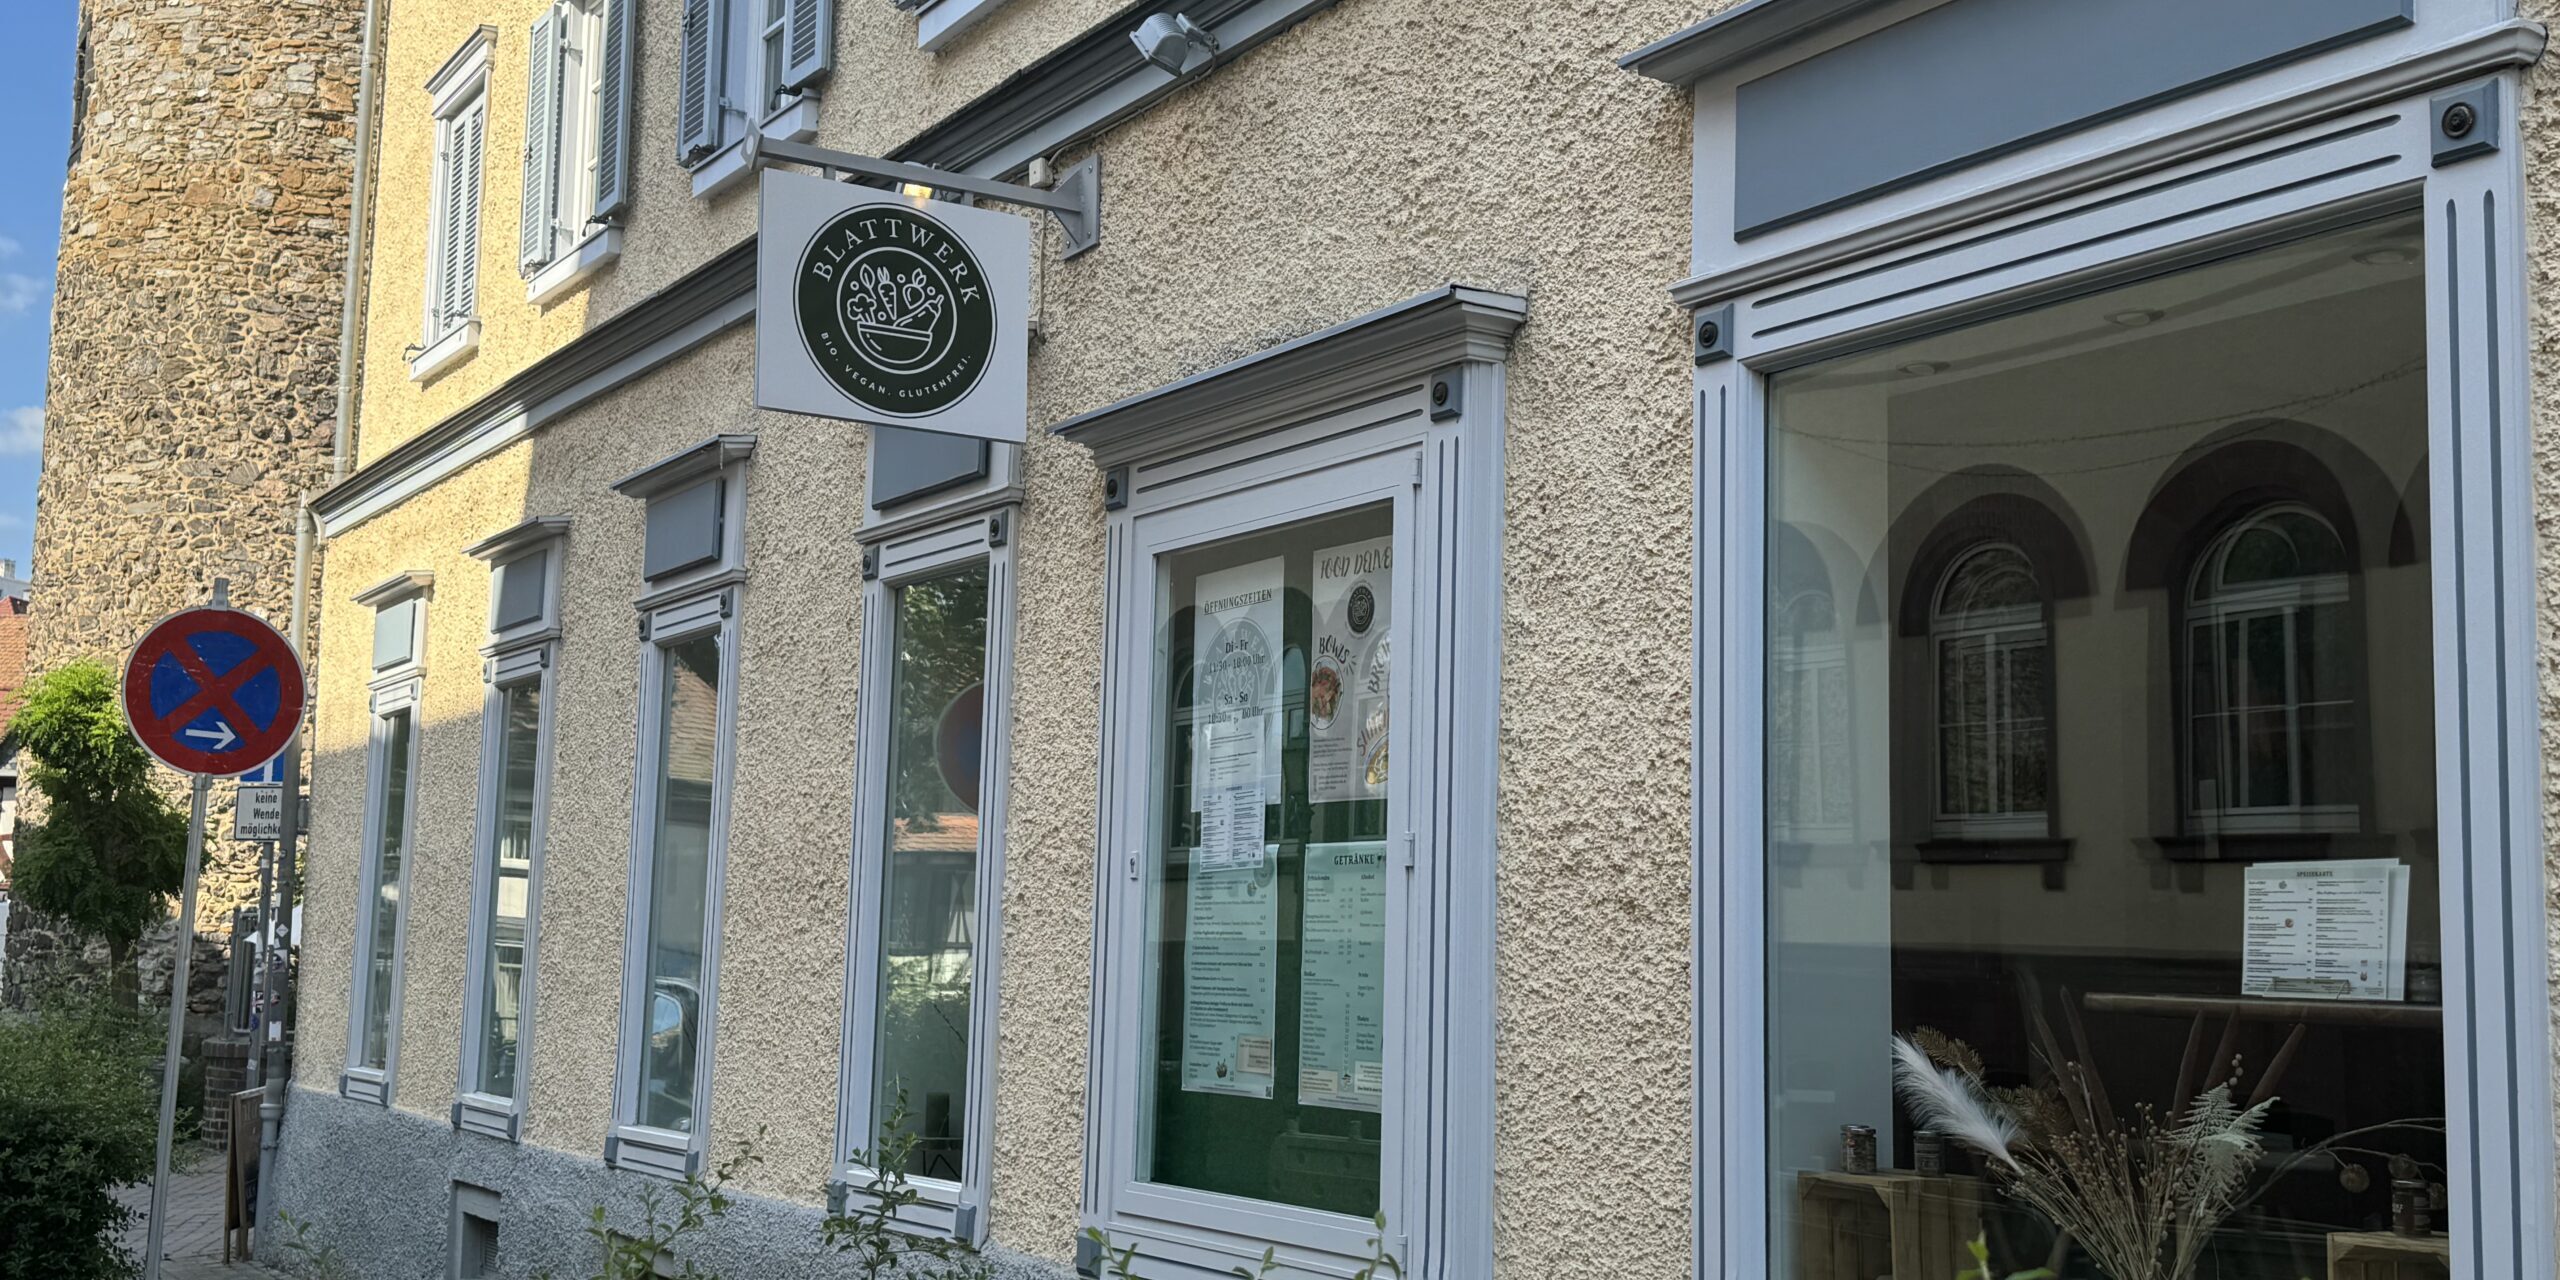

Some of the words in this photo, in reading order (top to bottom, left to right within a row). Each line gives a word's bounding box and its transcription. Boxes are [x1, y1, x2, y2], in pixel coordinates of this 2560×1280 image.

[812, 217, 981, 306] BLATTWERK
[819, 331, 841, 363] BIO.
[843, 363, 893, 397] VEGAN.
[898, 354, 974, 399] GLUTENFREI.
[1203, 588, 1273, 614] ÖFFNUNGSZEITEN
[1225, 641, 1234, 654] Di
[1240, 639, 1249, 651] Fr
[1318, 635, 1350, 665] BOWLS
[1252, 653, 1266, 665] Uhr
[1224, 694, 1233, 706] Sa
[1239, 690, 1249, 703] So
[255, 791, 278, 804] keine
[1333, 853, 1375, 866] GETRÄNKE
